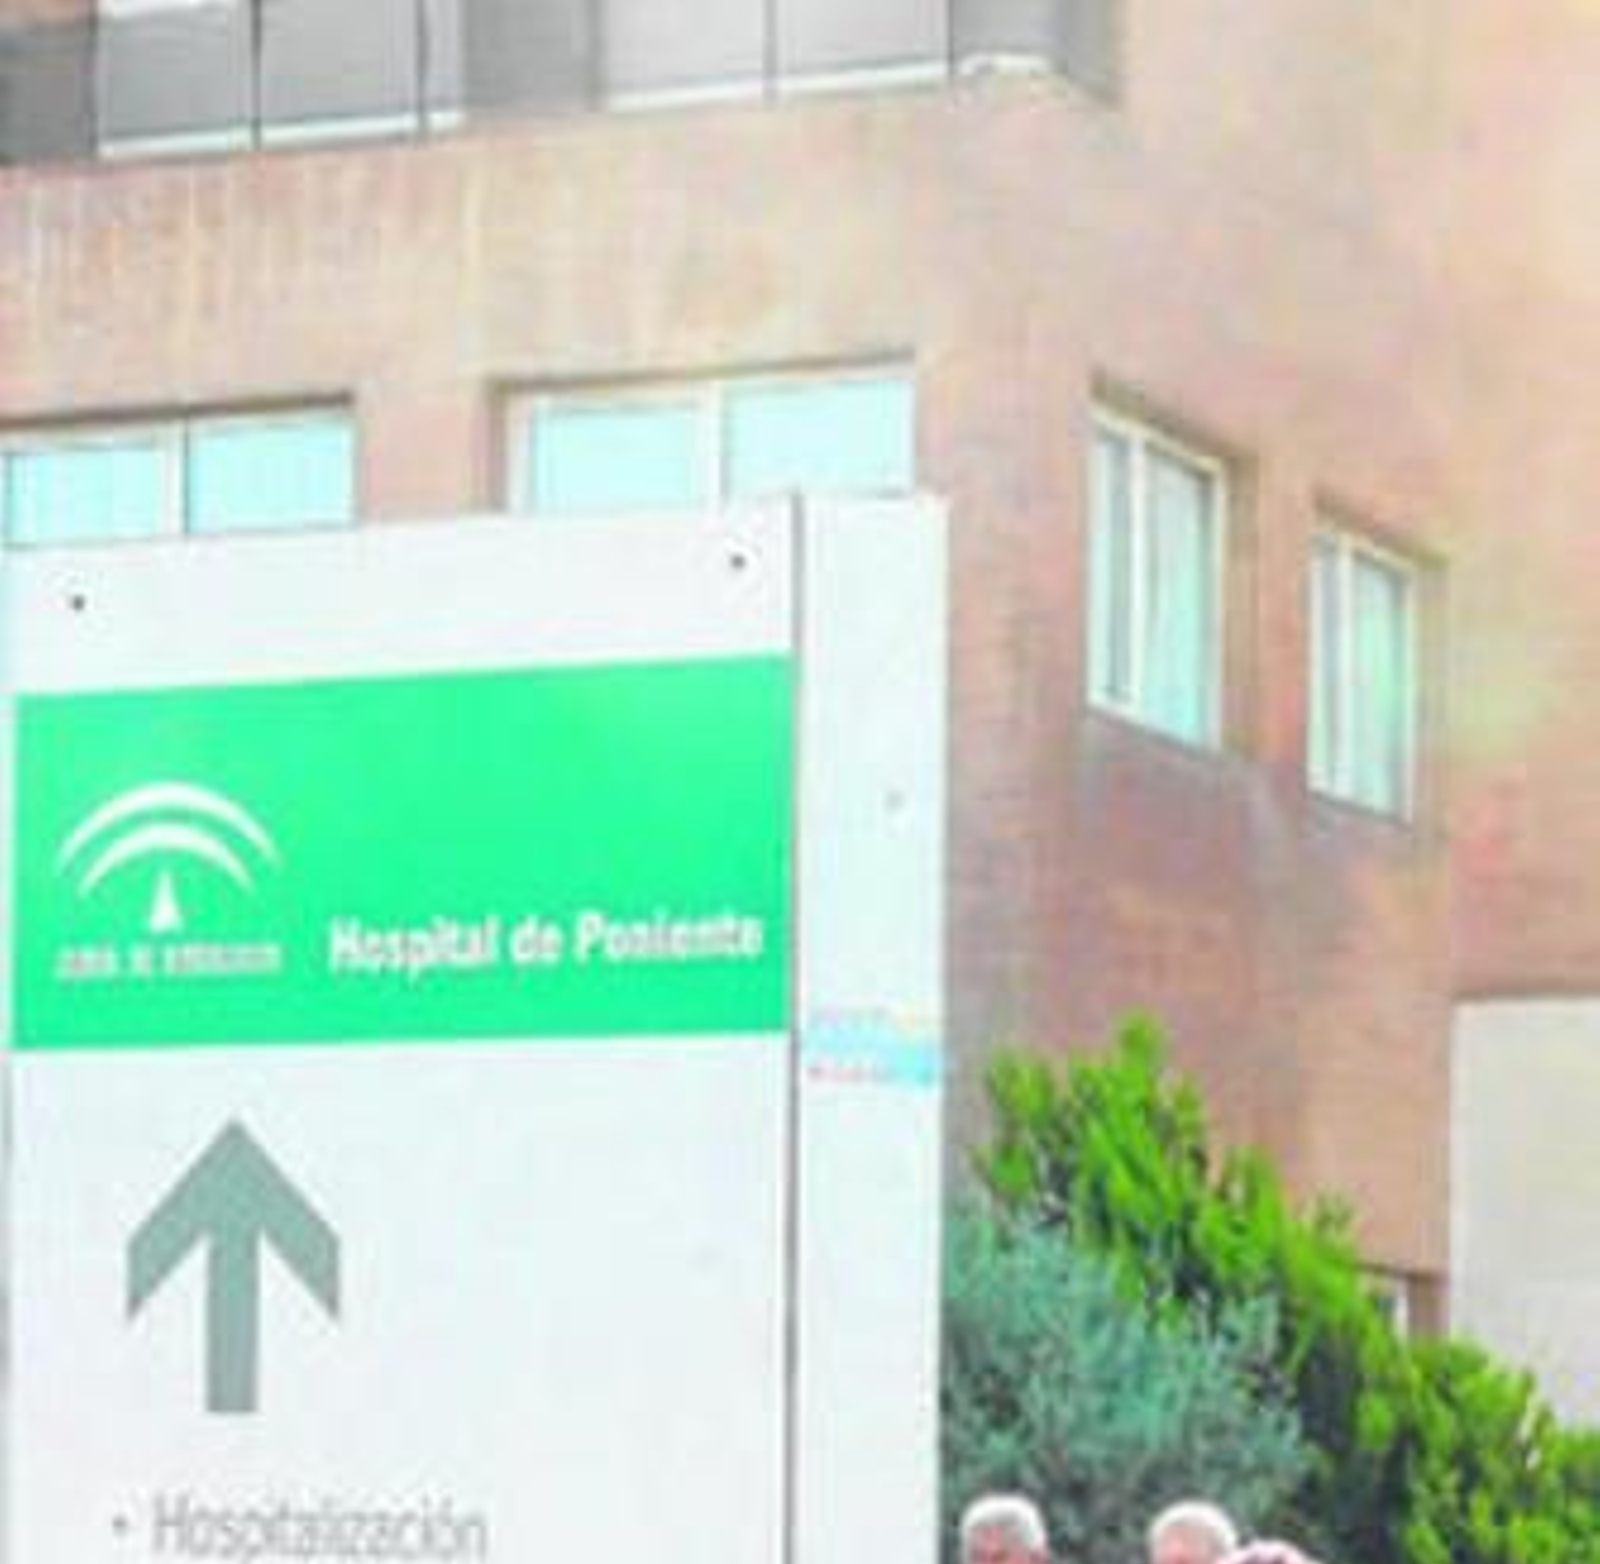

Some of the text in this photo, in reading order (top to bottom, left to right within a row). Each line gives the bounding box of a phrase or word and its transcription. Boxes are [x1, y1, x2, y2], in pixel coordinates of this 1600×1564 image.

[330, 913, 499, 982] Hospital
[509, 913, 563, 966] de
[575, 908, 765, 964] Poniente
[152, 1496, 488, 1564] Hospitalización
